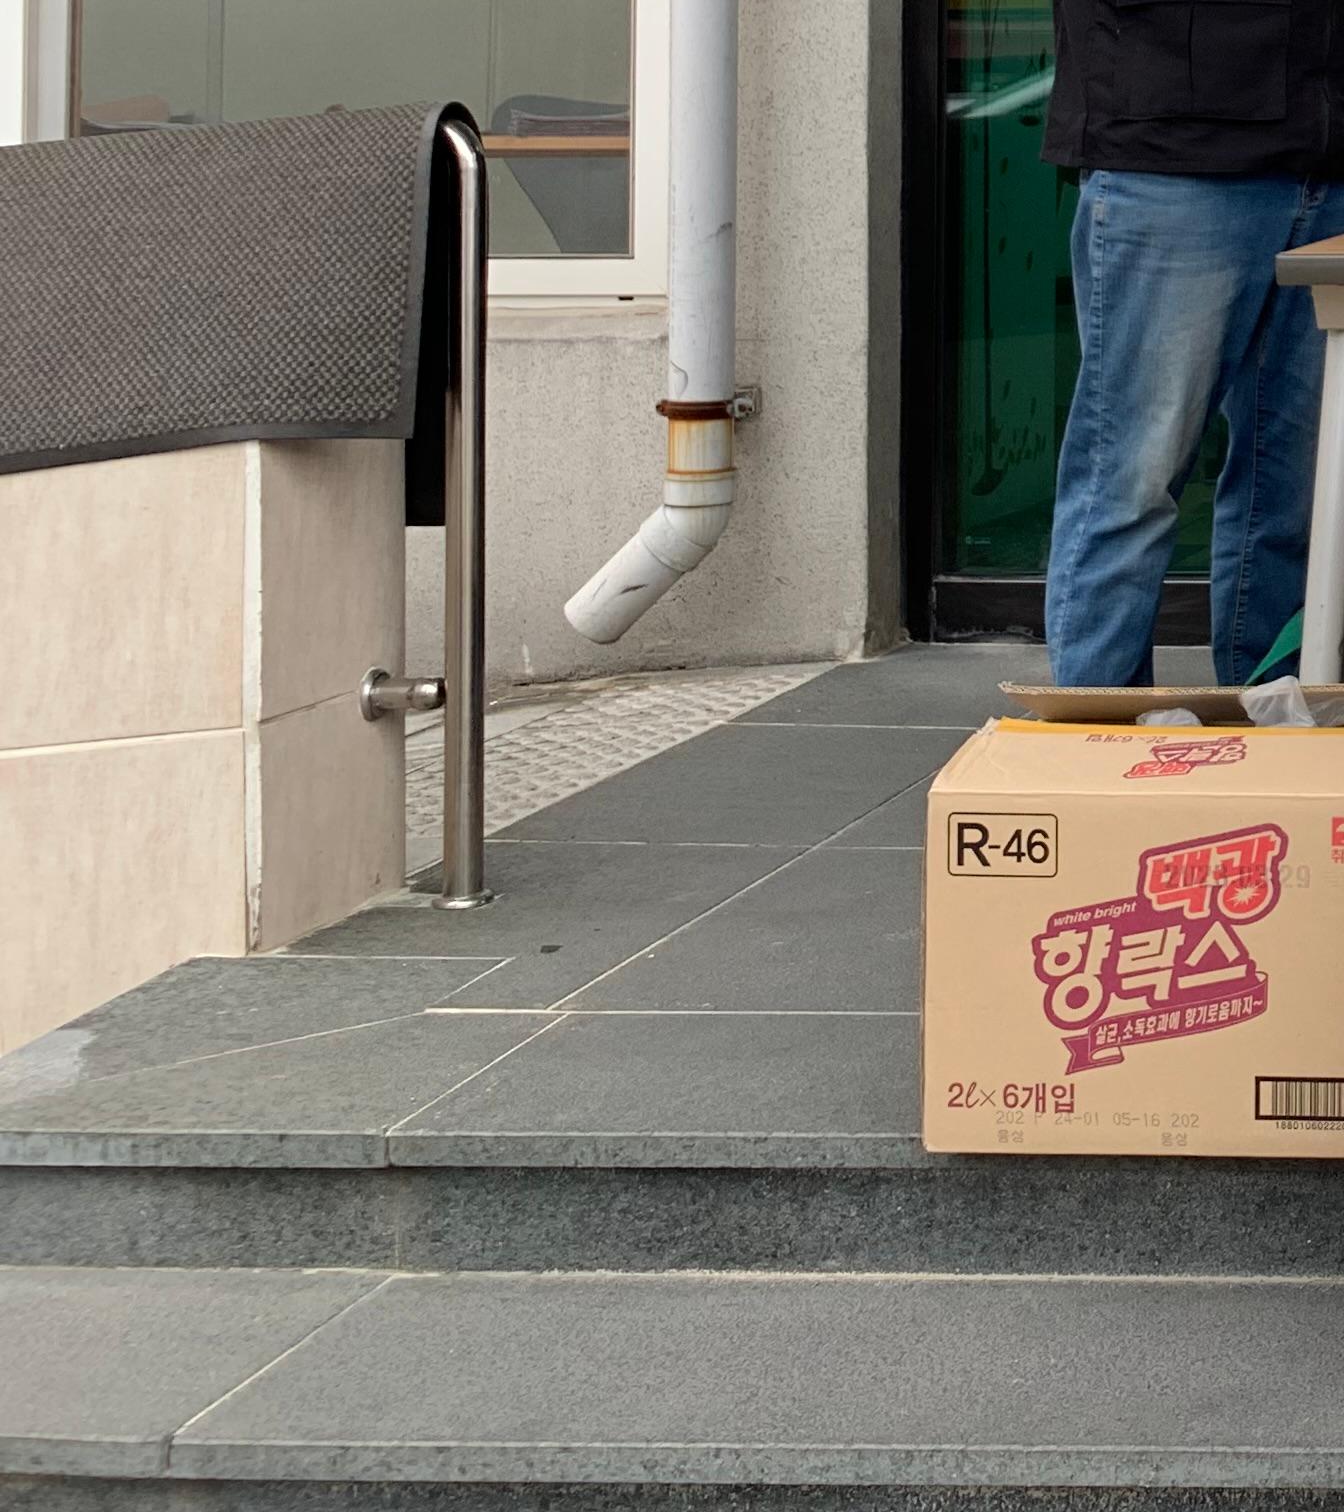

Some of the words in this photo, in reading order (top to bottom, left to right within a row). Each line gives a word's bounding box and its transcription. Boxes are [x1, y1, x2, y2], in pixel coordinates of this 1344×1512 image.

[957, 822, 1050, 866] R-46
[1145, 830, 1277, 918] 백광
[1052, 909, 1091, 928] white
[1094, 899, 1137, 921] bright
[1038, 920, 1249, 1025] 향락스
[1002, 1081, 1075, 1113] 6개입
